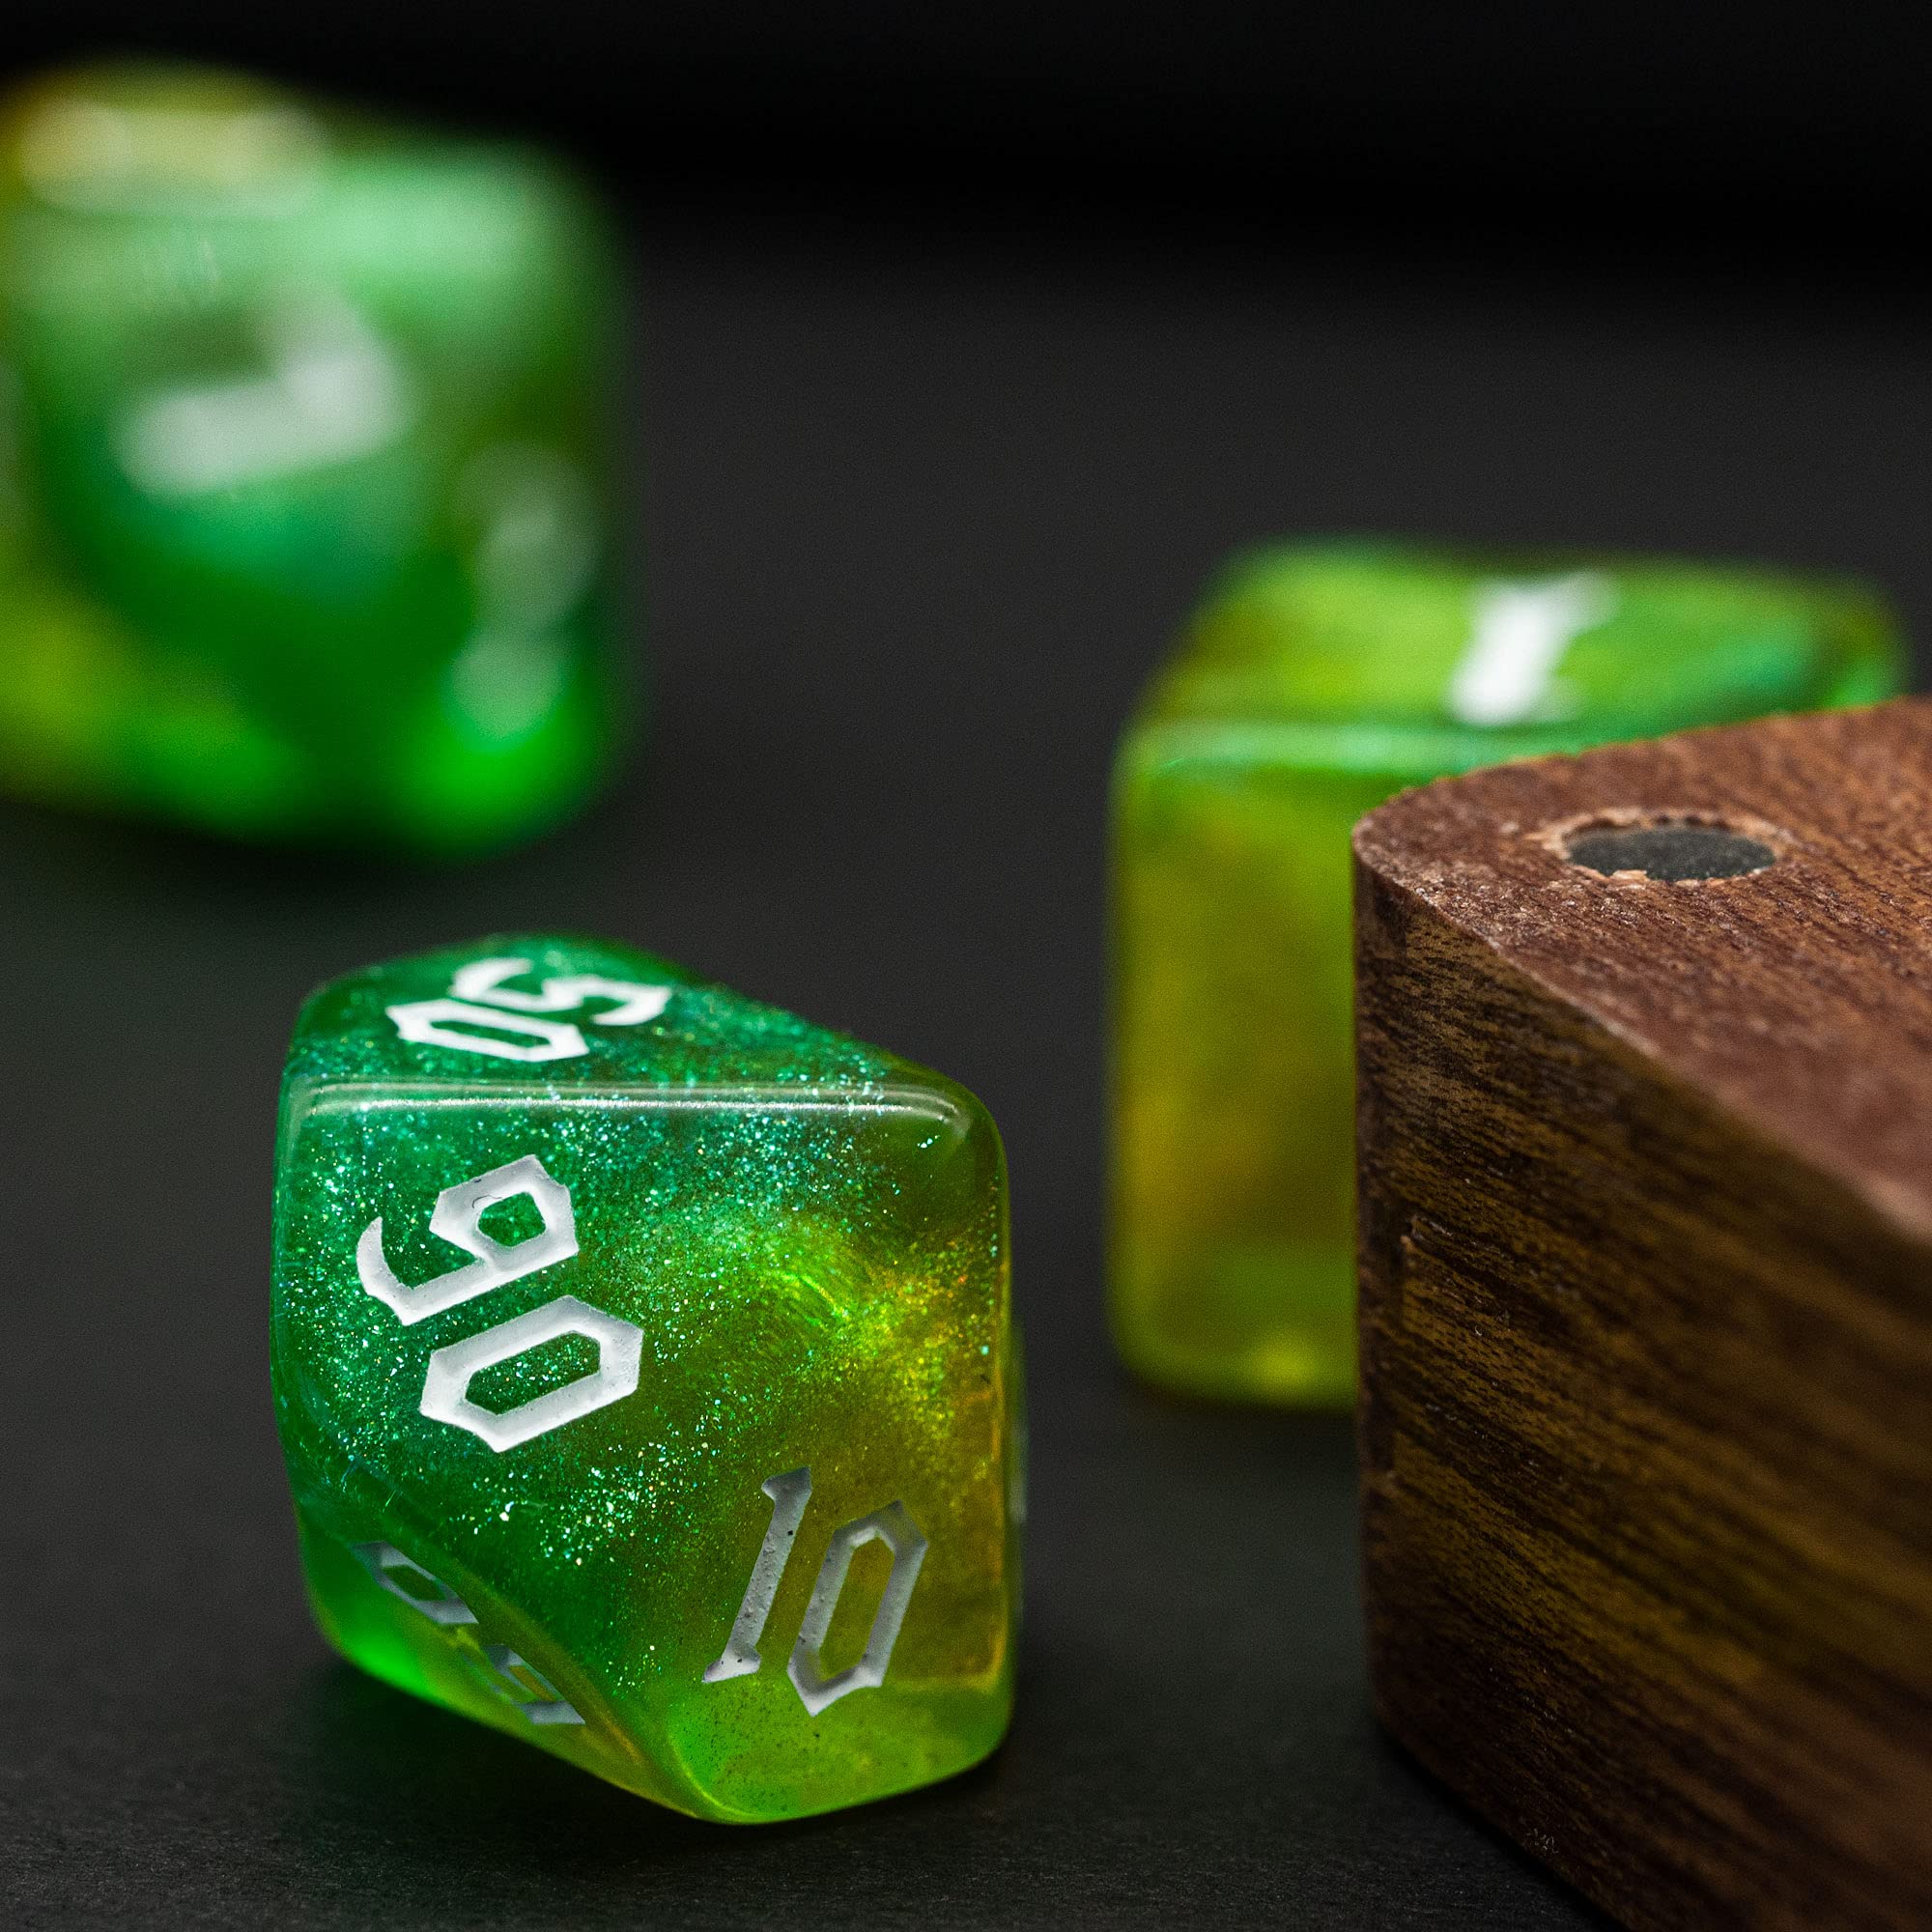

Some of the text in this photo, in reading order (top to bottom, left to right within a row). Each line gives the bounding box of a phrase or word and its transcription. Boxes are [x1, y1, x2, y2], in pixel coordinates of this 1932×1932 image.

[387, 957, 672, 1064] 50
[355, 1154, 644, 1453] 90
[701, 1466, 927, 1716] 10
